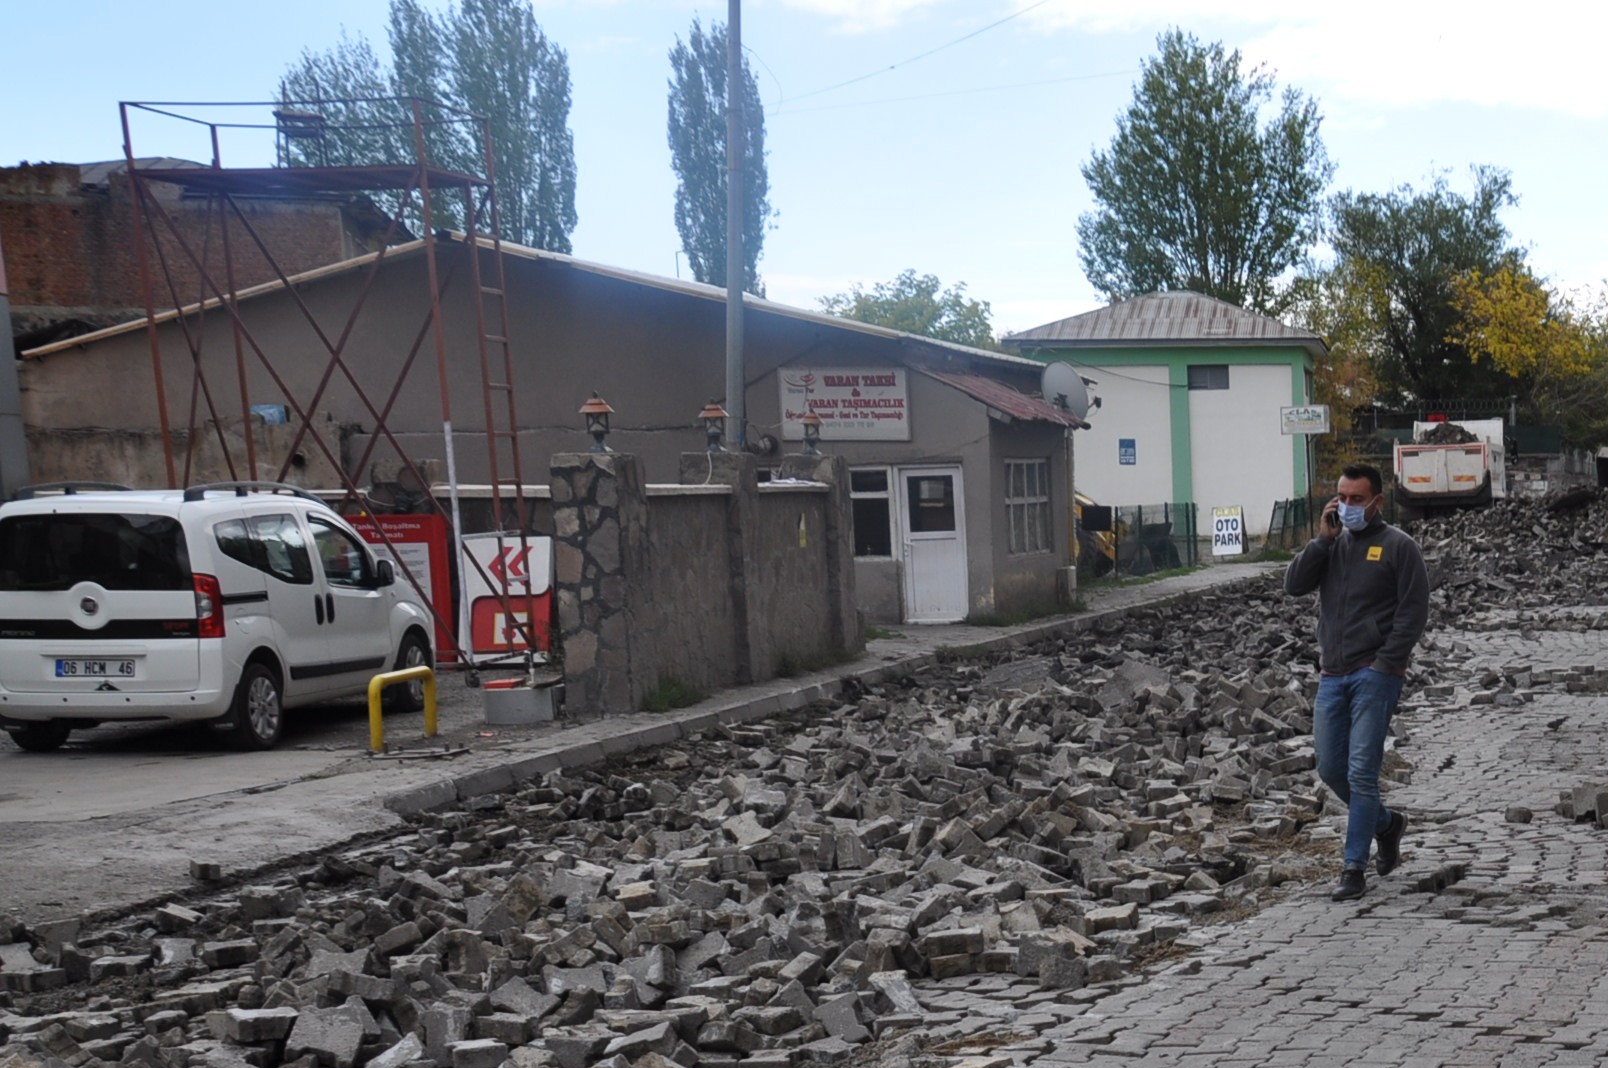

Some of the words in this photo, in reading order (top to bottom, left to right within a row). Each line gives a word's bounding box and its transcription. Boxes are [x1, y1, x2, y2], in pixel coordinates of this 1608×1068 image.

[824, 375, 859, 387] VARAN
[841, 399, 904, 411] TAŞIMACILIK
[382, 523, 421, 531] Boşaltma
[1215, 518, 1239, 532] OTO
[1214, 532, 1241, 547] PARK
[63, 662, 77, 674] 06
[84, 662, 106, 674] HCM
[119, 662, 133, 674] 46
